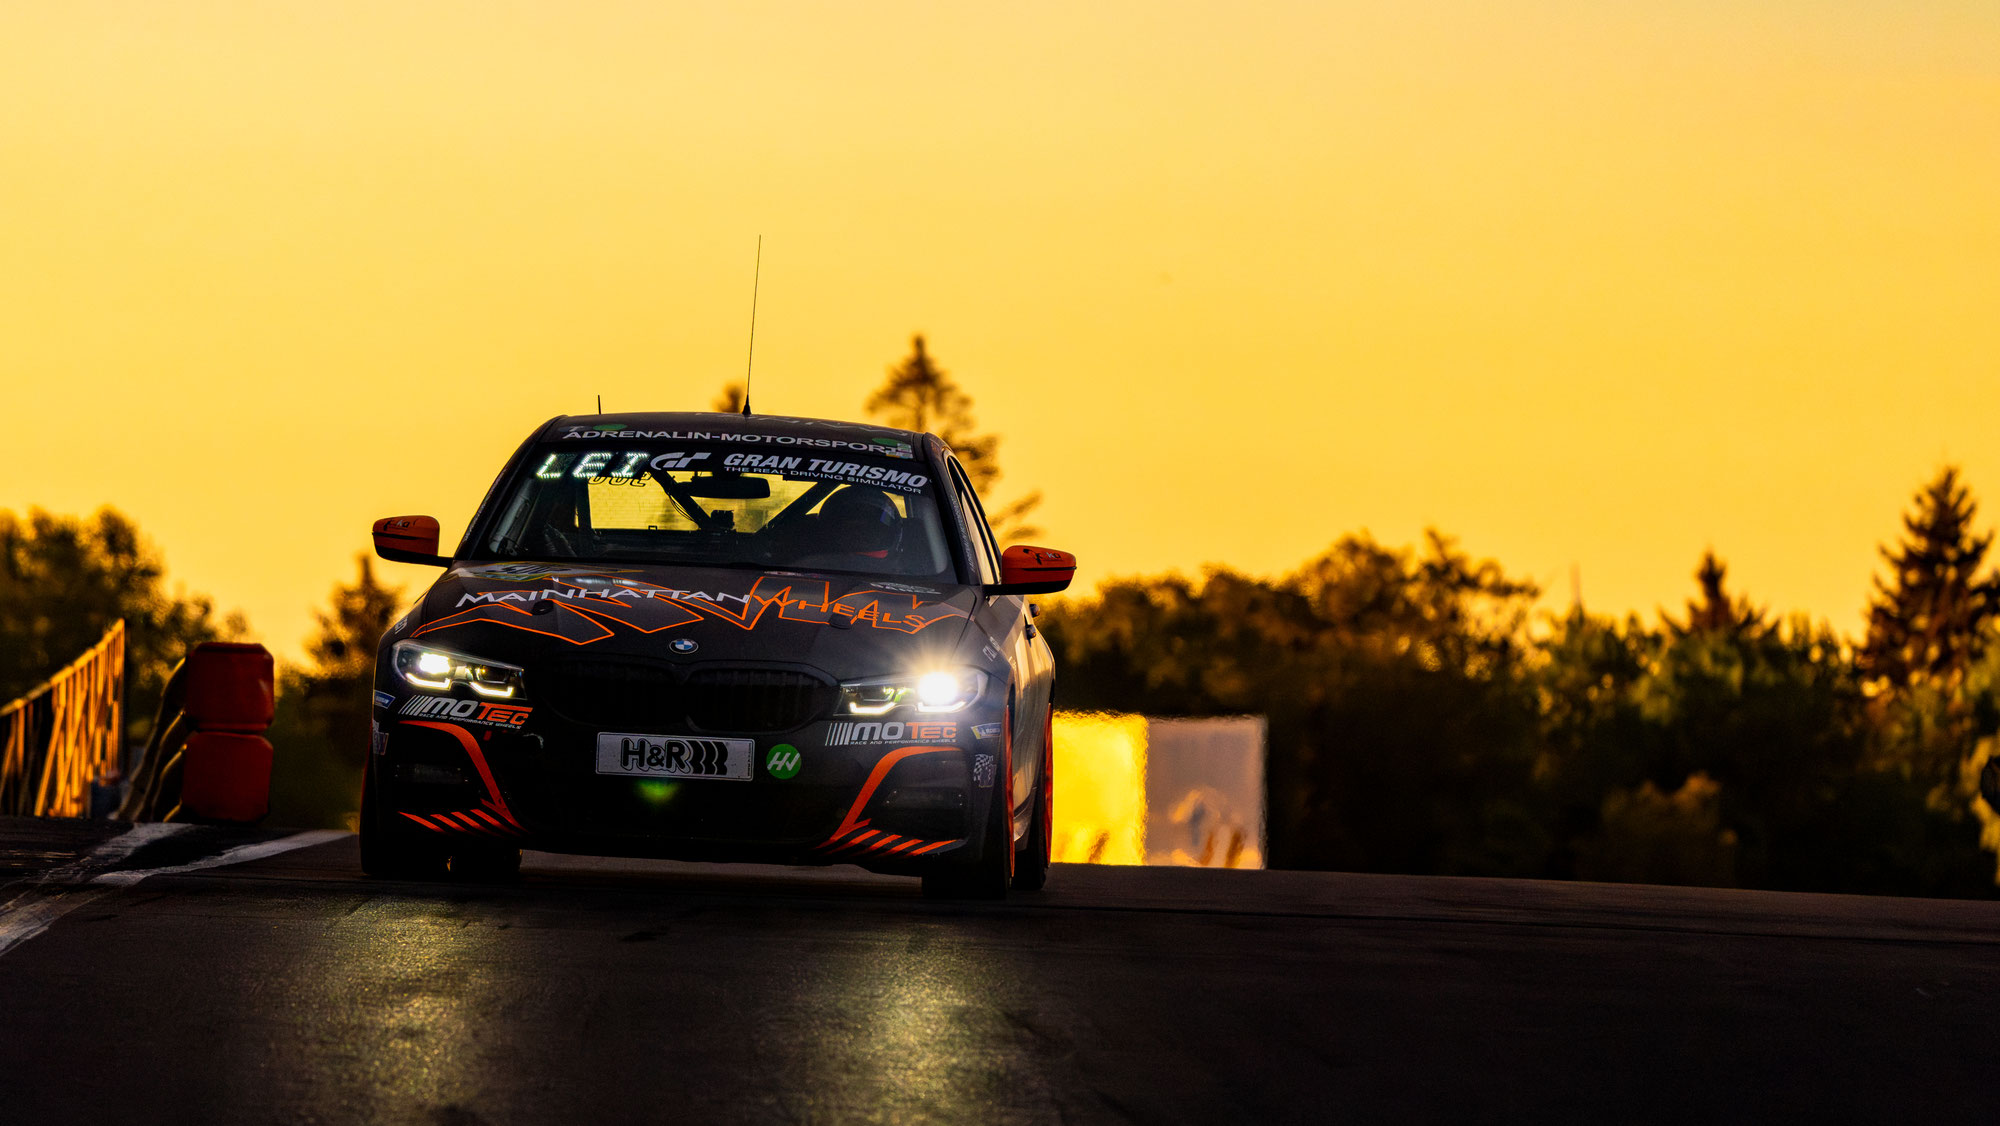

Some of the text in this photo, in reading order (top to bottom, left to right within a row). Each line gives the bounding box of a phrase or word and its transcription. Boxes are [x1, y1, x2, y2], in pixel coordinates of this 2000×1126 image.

[537, 451, 650, 479] LEI
[723, 453, 929, 488] GRAN TURISMO
[753, 467, 788, 475] REAL
[790, 470, 844, 481] DRIVING
[847, 476, 922, 494] SIMULATOR
[455, 588, 750, 608] MAINHATTAN
[495, 722, 522, 730] WHEELS
[621, 738, 691, 774] H&R
